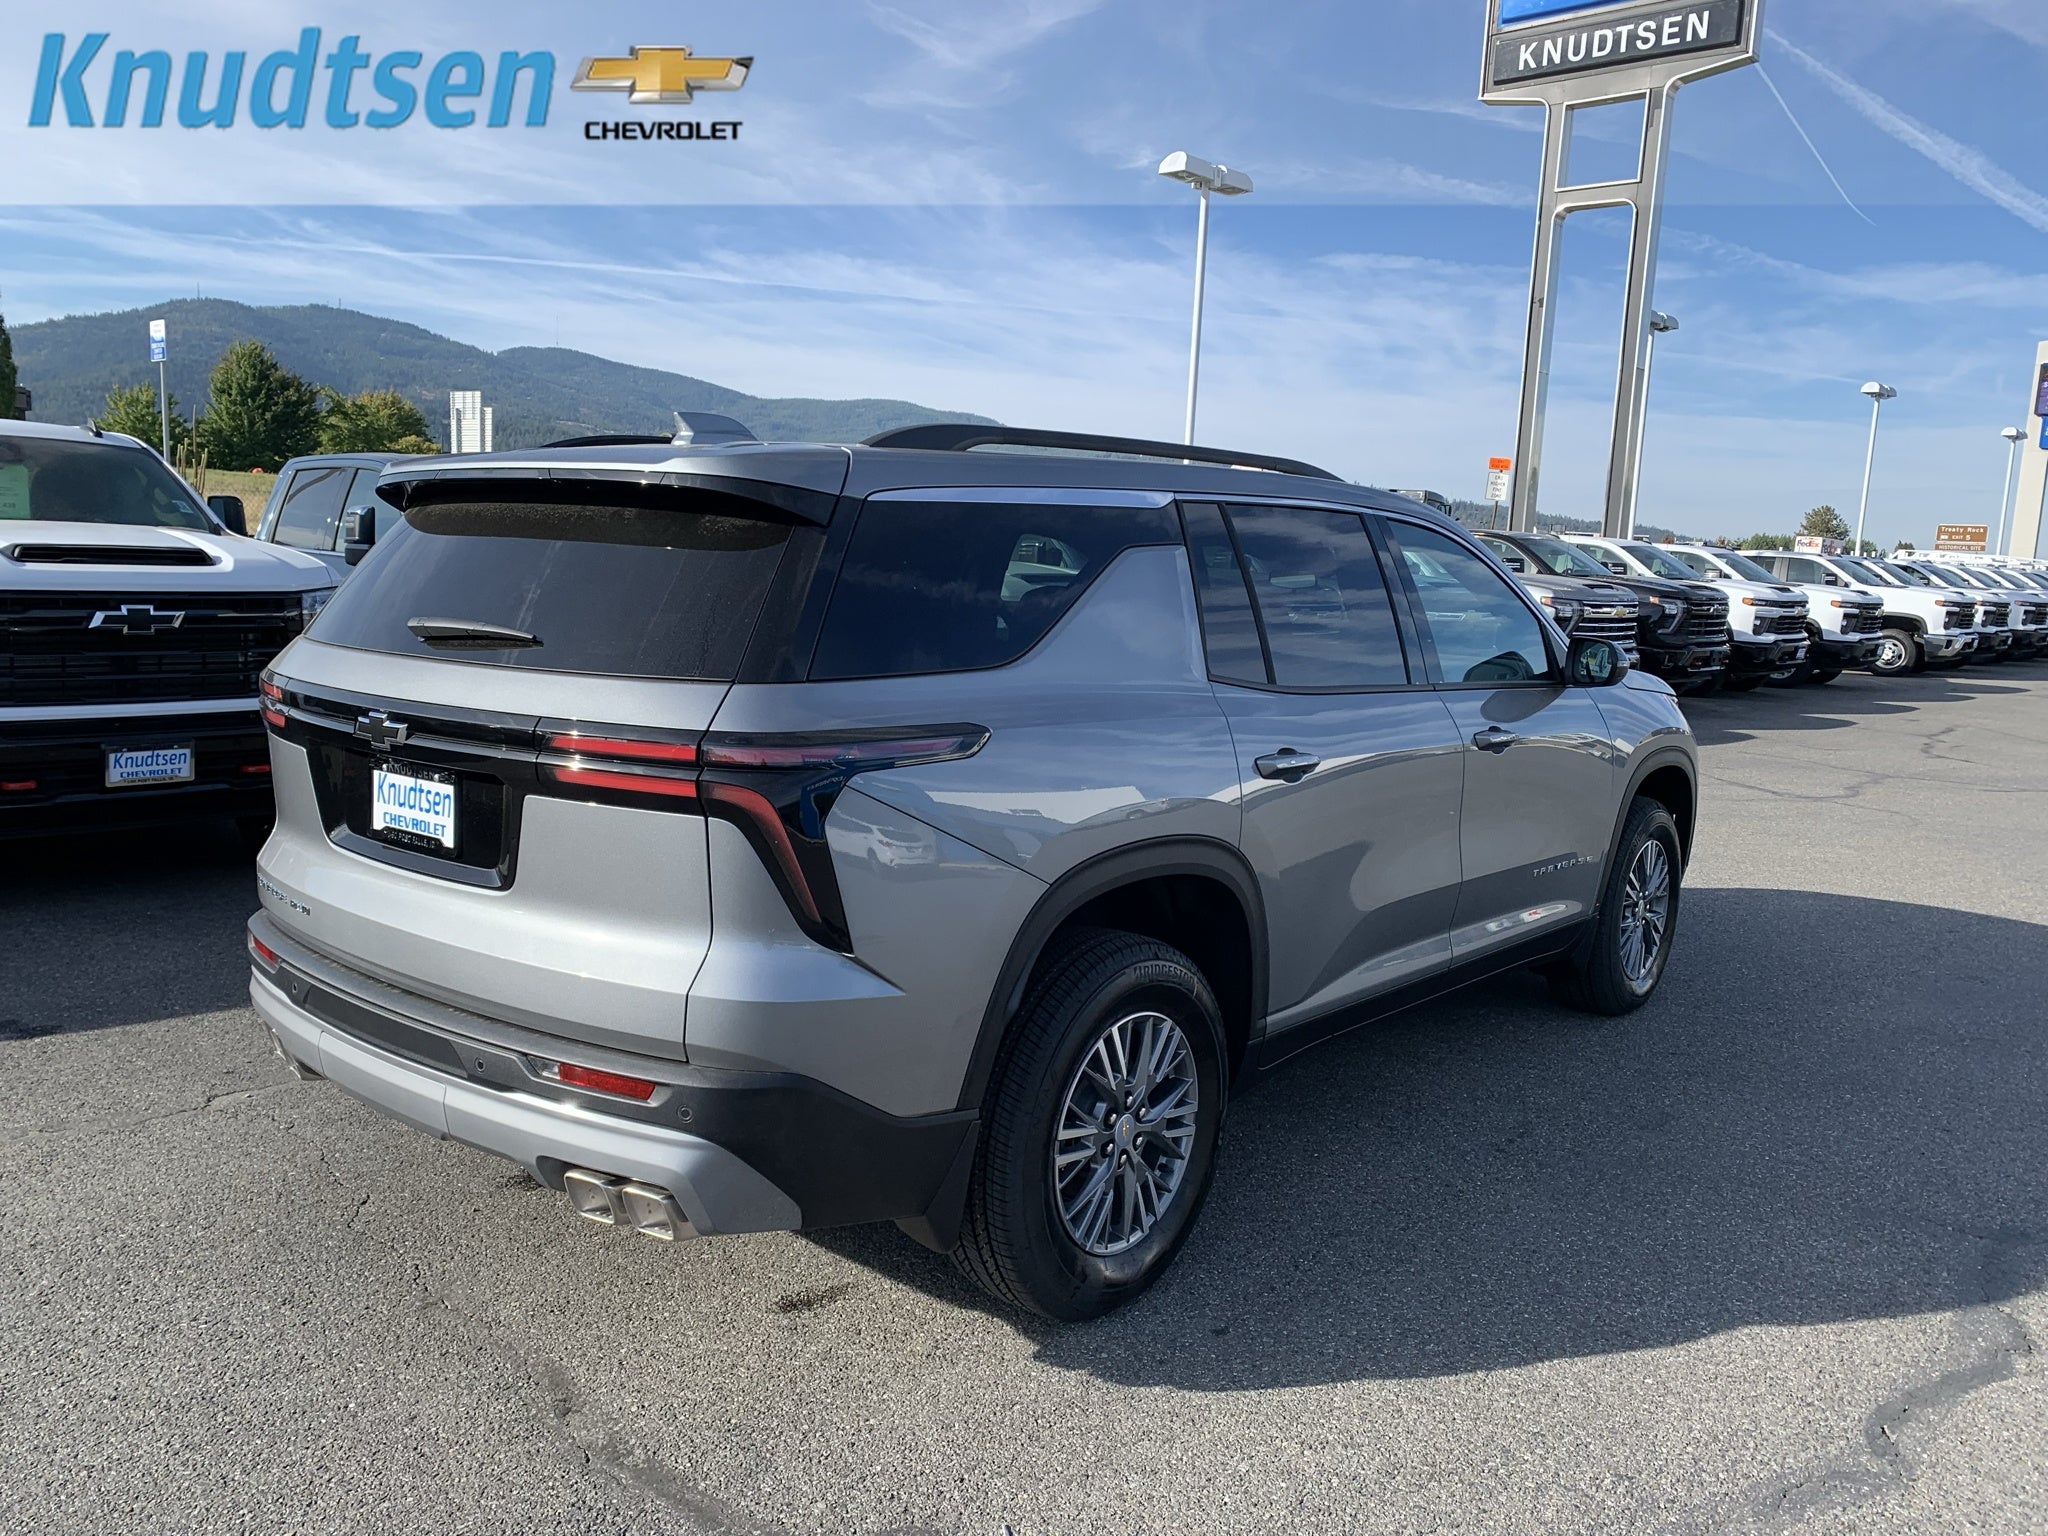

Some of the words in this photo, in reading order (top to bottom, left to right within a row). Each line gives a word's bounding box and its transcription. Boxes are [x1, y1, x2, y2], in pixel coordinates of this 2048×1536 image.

[1517, 10, 1710, 71] KNUDTSEN
[1941, 526, 1964, 534] Treaty
[1797, 539, 1820, 548] FedEx
[113, 750, 187, 769] Knudtsen
[120, 767, 183, 778] CHEVROLET
[377, 772, 451, 818] Knudtsen
[383, 811, 447, 838] CHEVROLET
[1532, 855, 1594, 878] TRAVERSE
